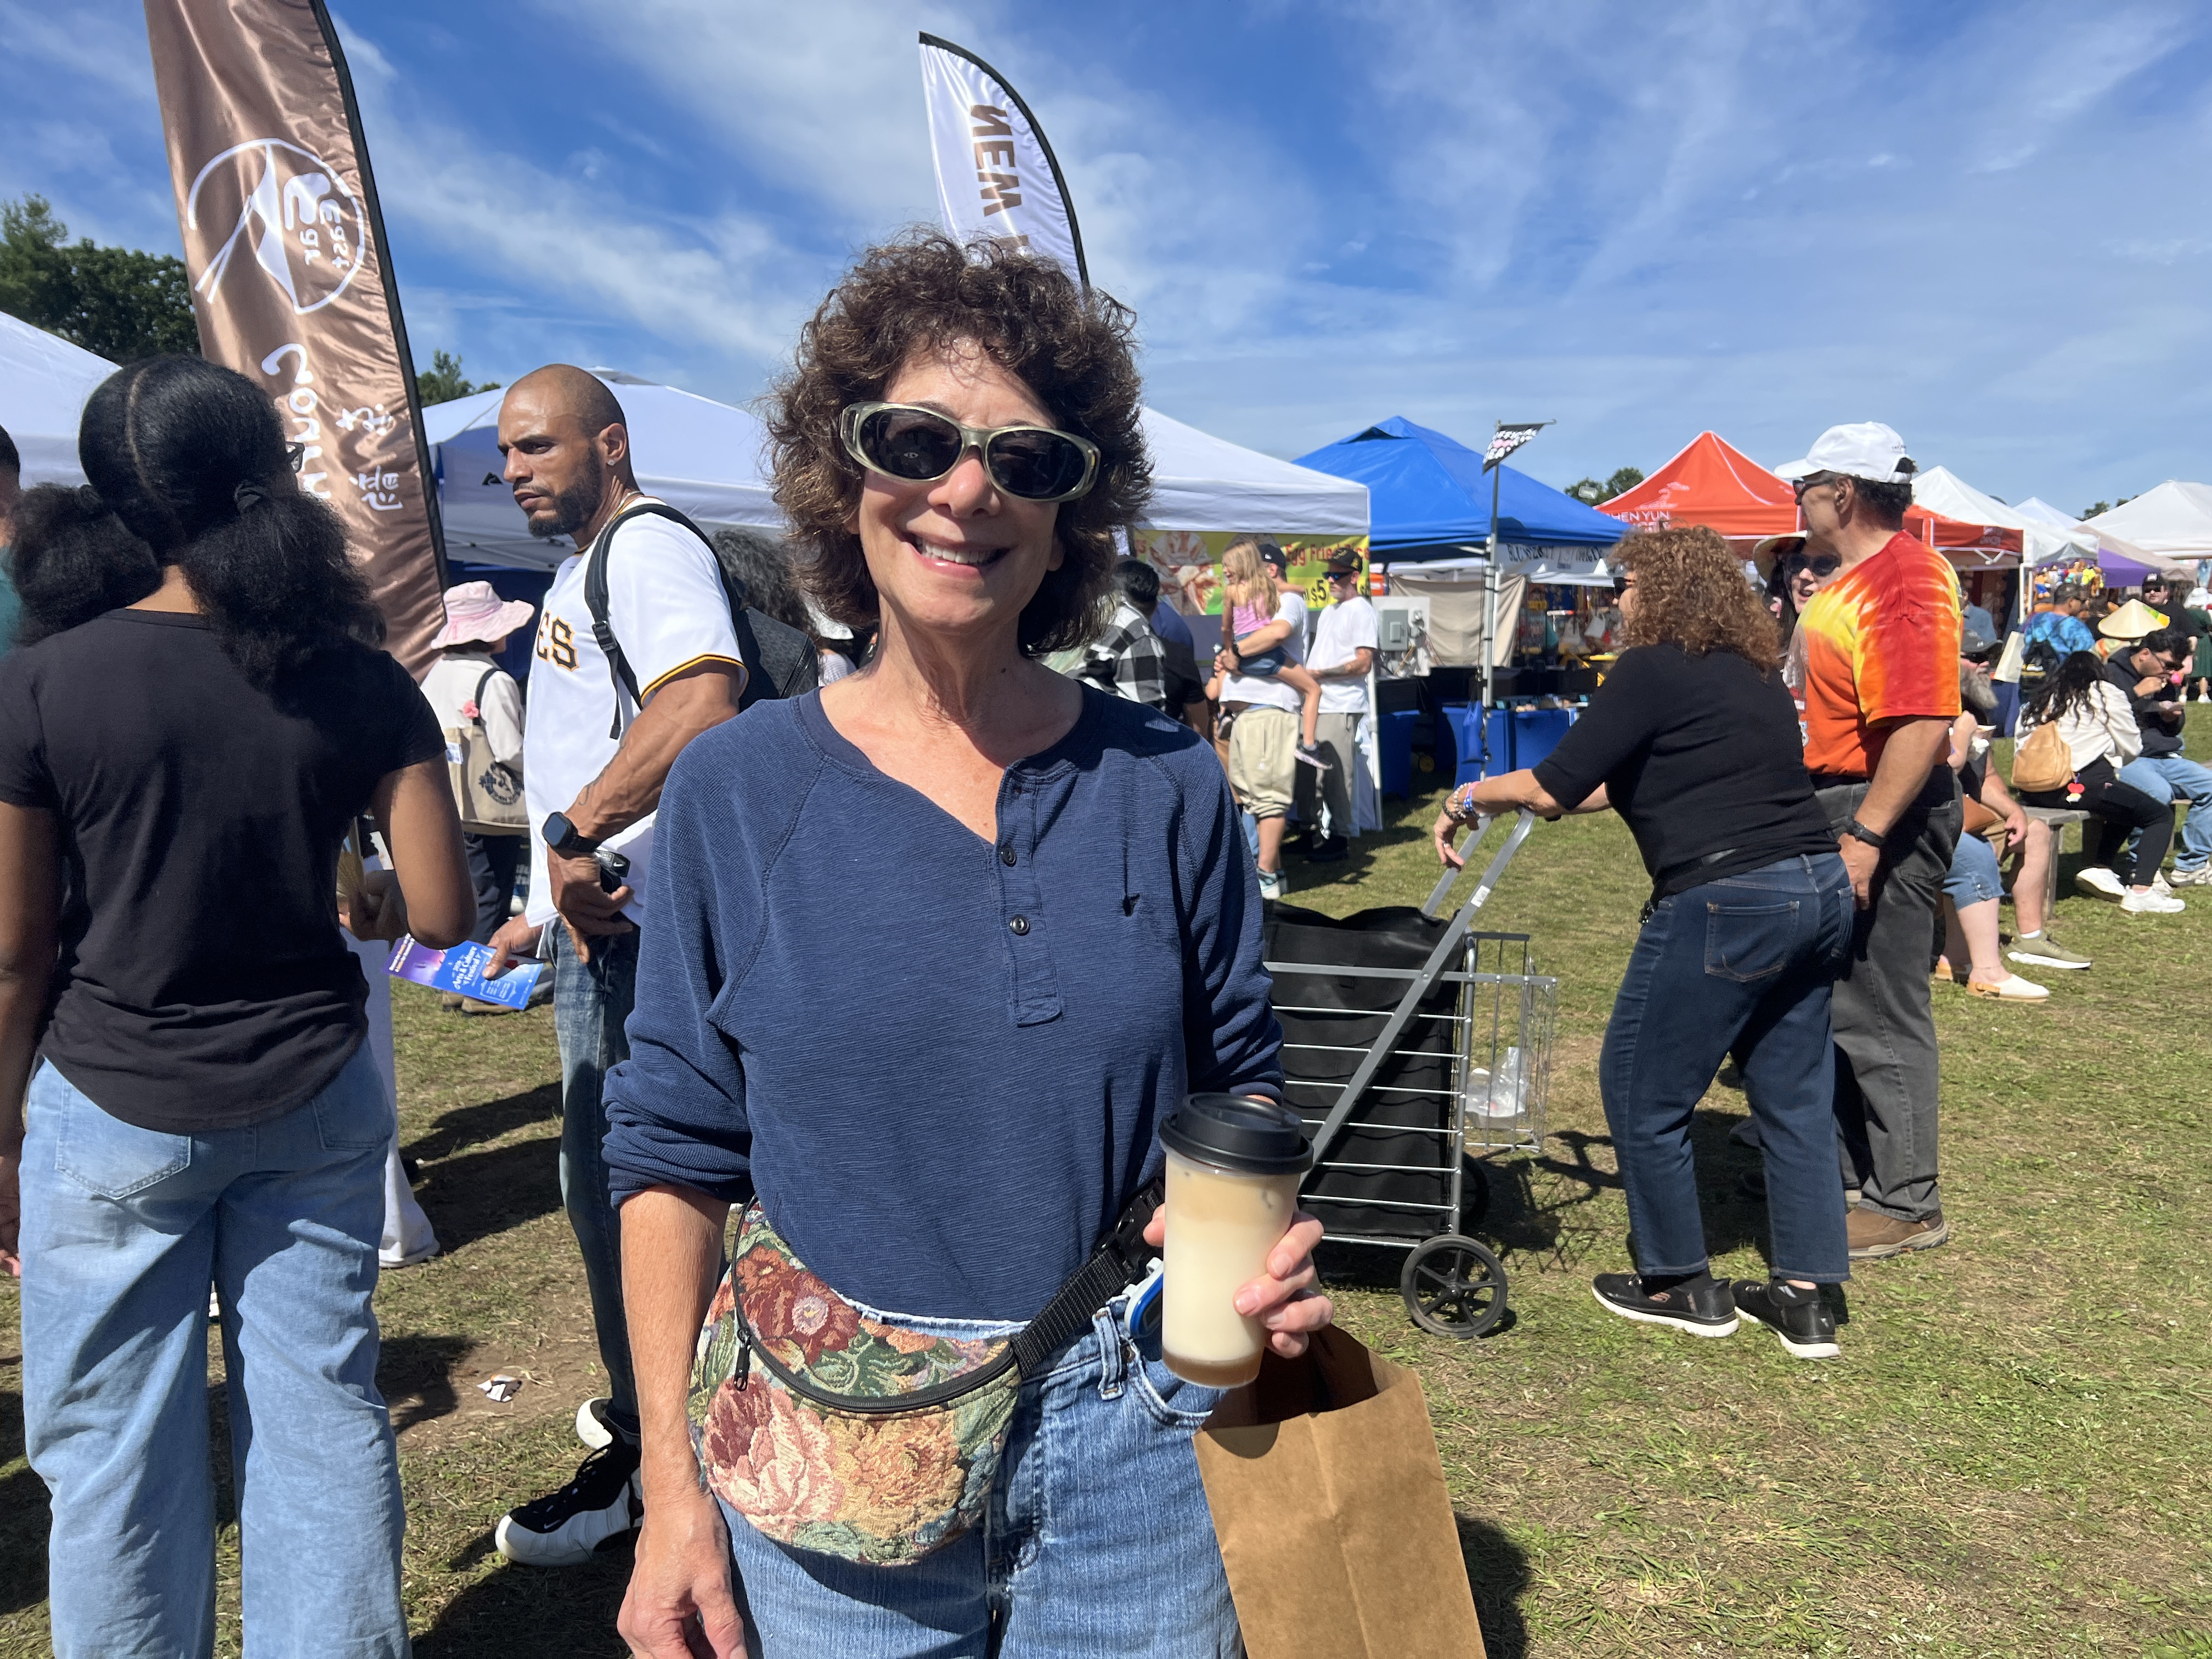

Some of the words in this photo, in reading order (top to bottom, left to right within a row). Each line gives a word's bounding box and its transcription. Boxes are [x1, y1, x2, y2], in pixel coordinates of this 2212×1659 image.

[1606, 510, 1640, 523] HEN
[1641, 510, 1671, 522] YUN
[1285, 544, 1306, 567] Egg
